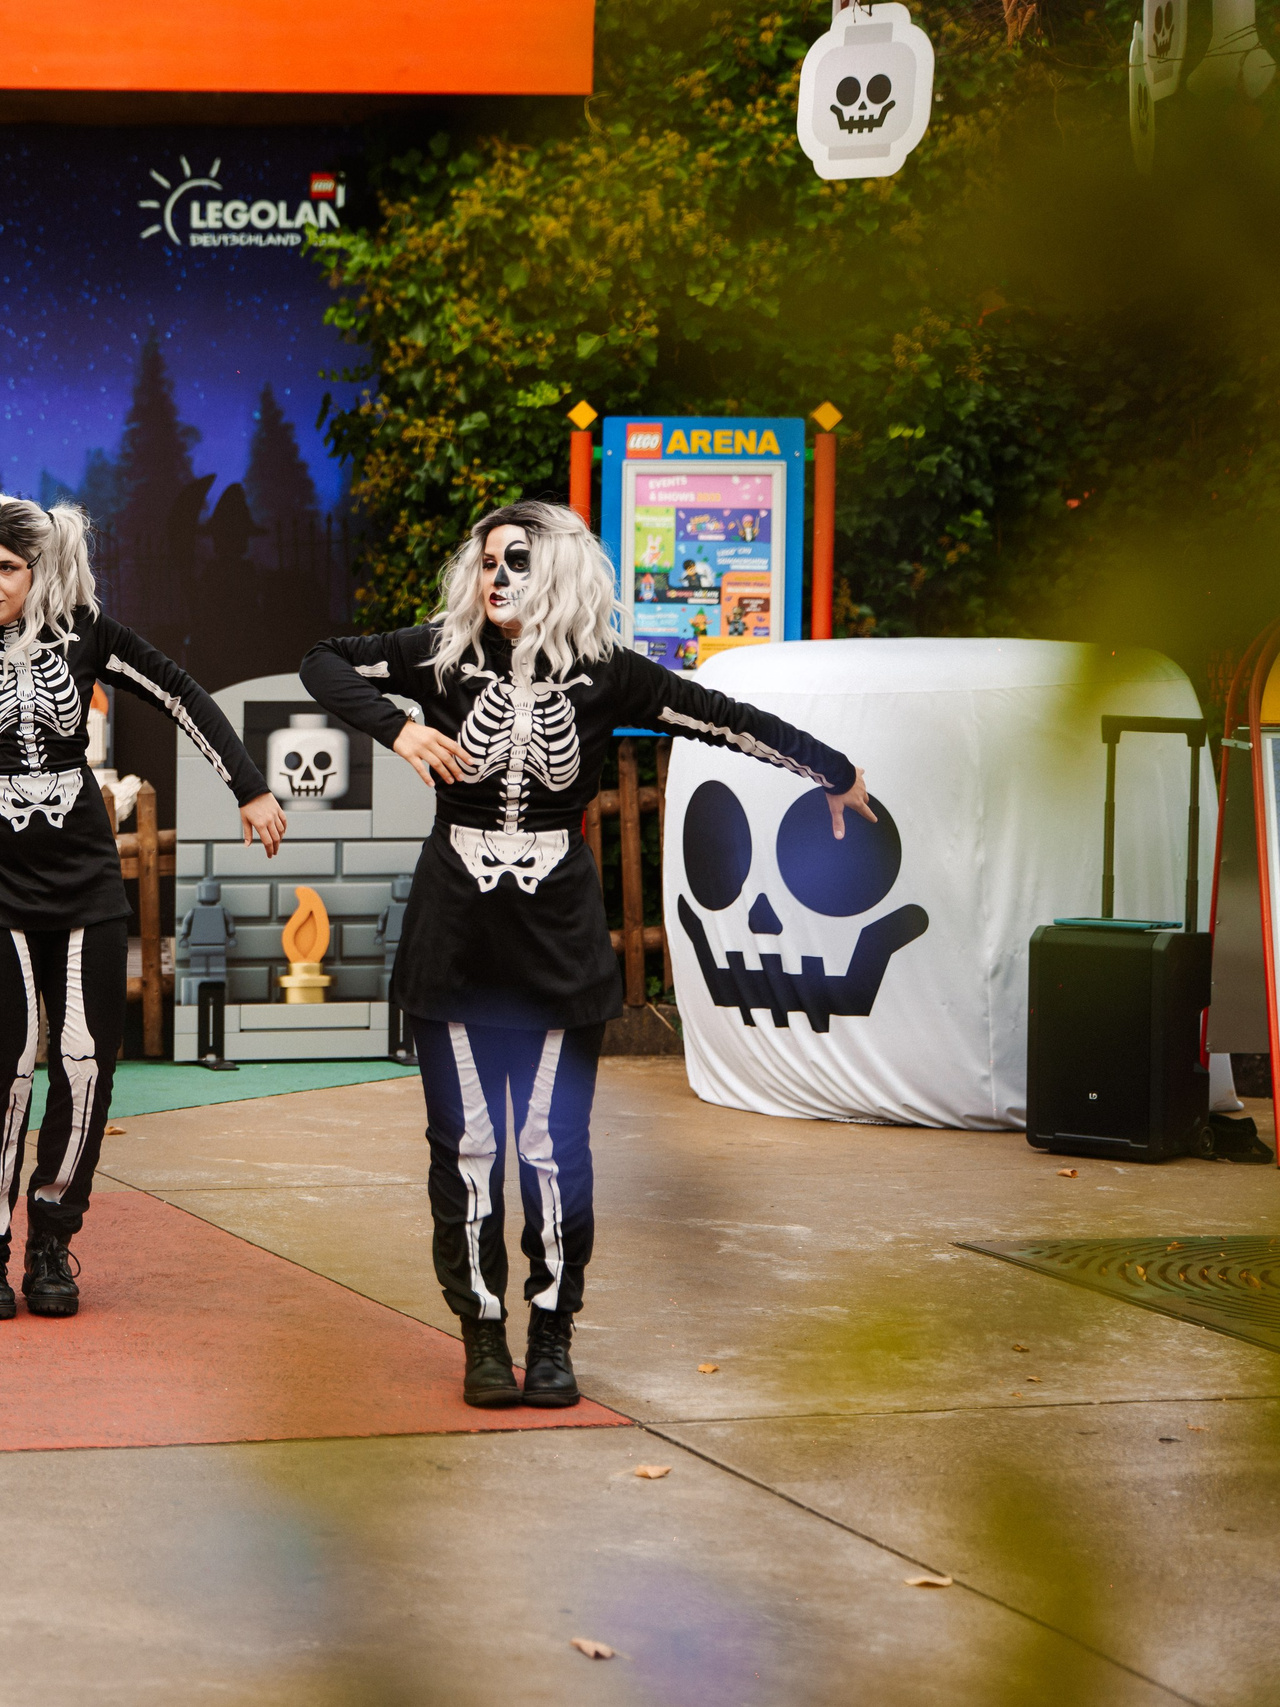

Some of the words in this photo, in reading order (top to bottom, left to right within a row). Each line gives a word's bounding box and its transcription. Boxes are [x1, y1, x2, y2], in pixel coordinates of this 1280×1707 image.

[190, 184, 345, 229] LEGOLAN
[190, 233, 302, 247] DEUTSCHLAND
[628, 433, 660, 449] LEGO
[666, 429, 781, 455] ARENA
[648, 475, 687, 489] EVENTS
[658, 492, 695, 501] SHOWS
